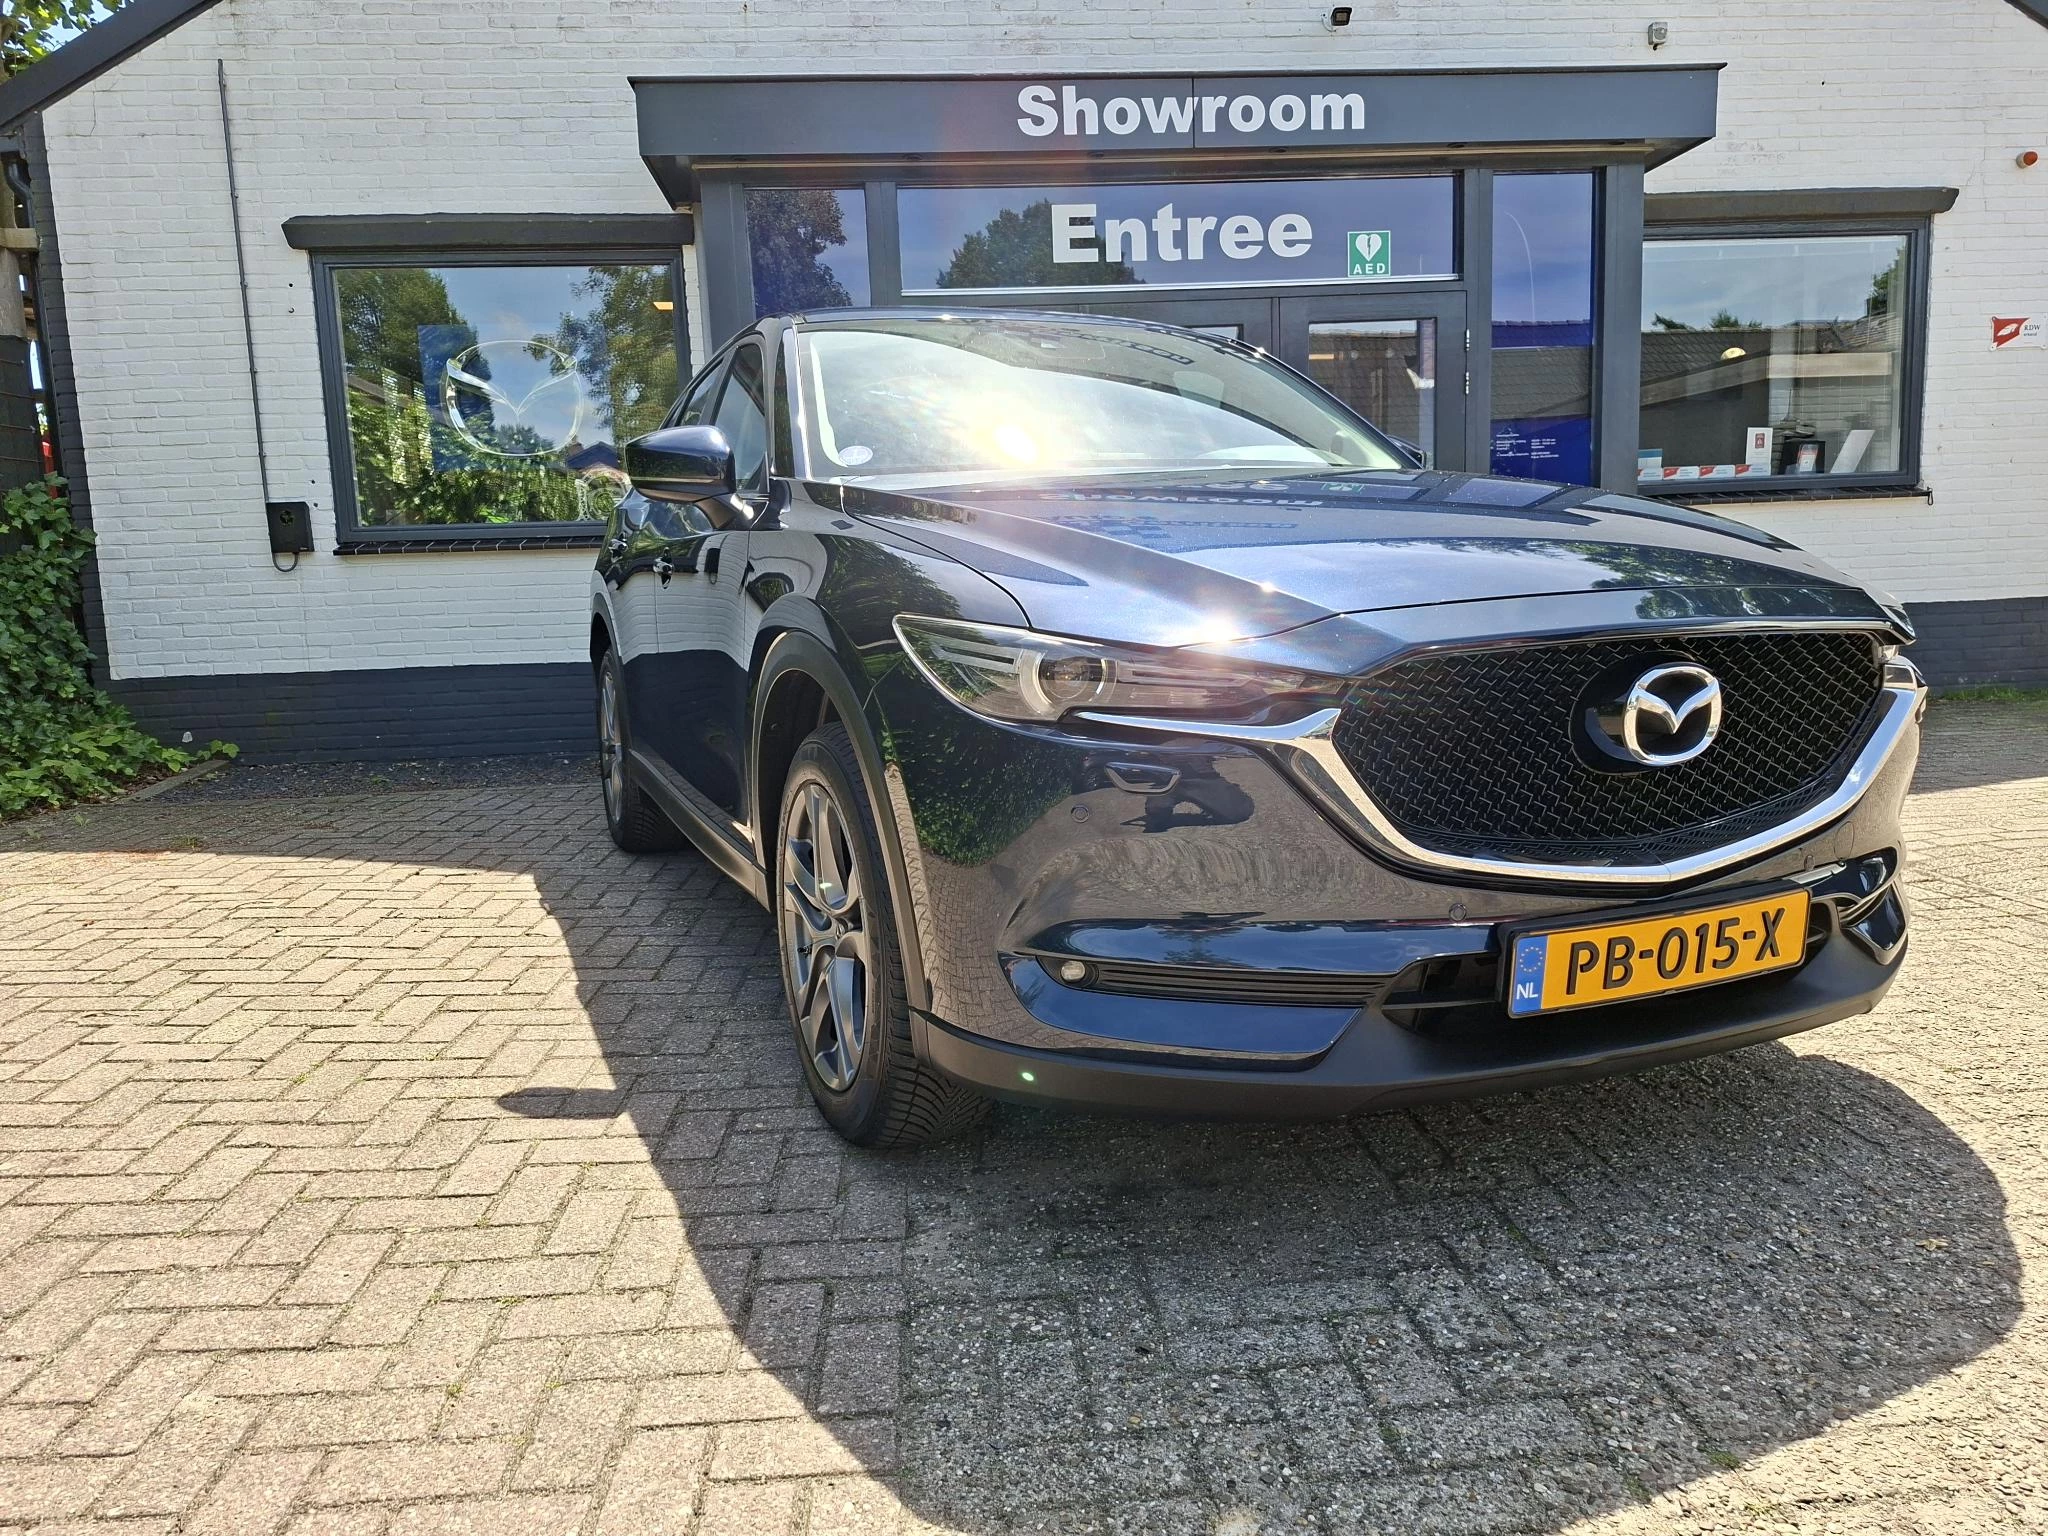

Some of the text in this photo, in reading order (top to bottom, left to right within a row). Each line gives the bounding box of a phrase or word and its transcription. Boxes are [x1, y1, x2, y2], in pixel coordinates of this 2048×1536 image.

[1017, 85, 1365, 136] Showroom
[1051, 203, 1313, 263] Entree
[1353, 263, 1386, 275] AED
[1566, 908, 1785, 995] PB-015-X
[1516, 982, 1539, 1000] NL
